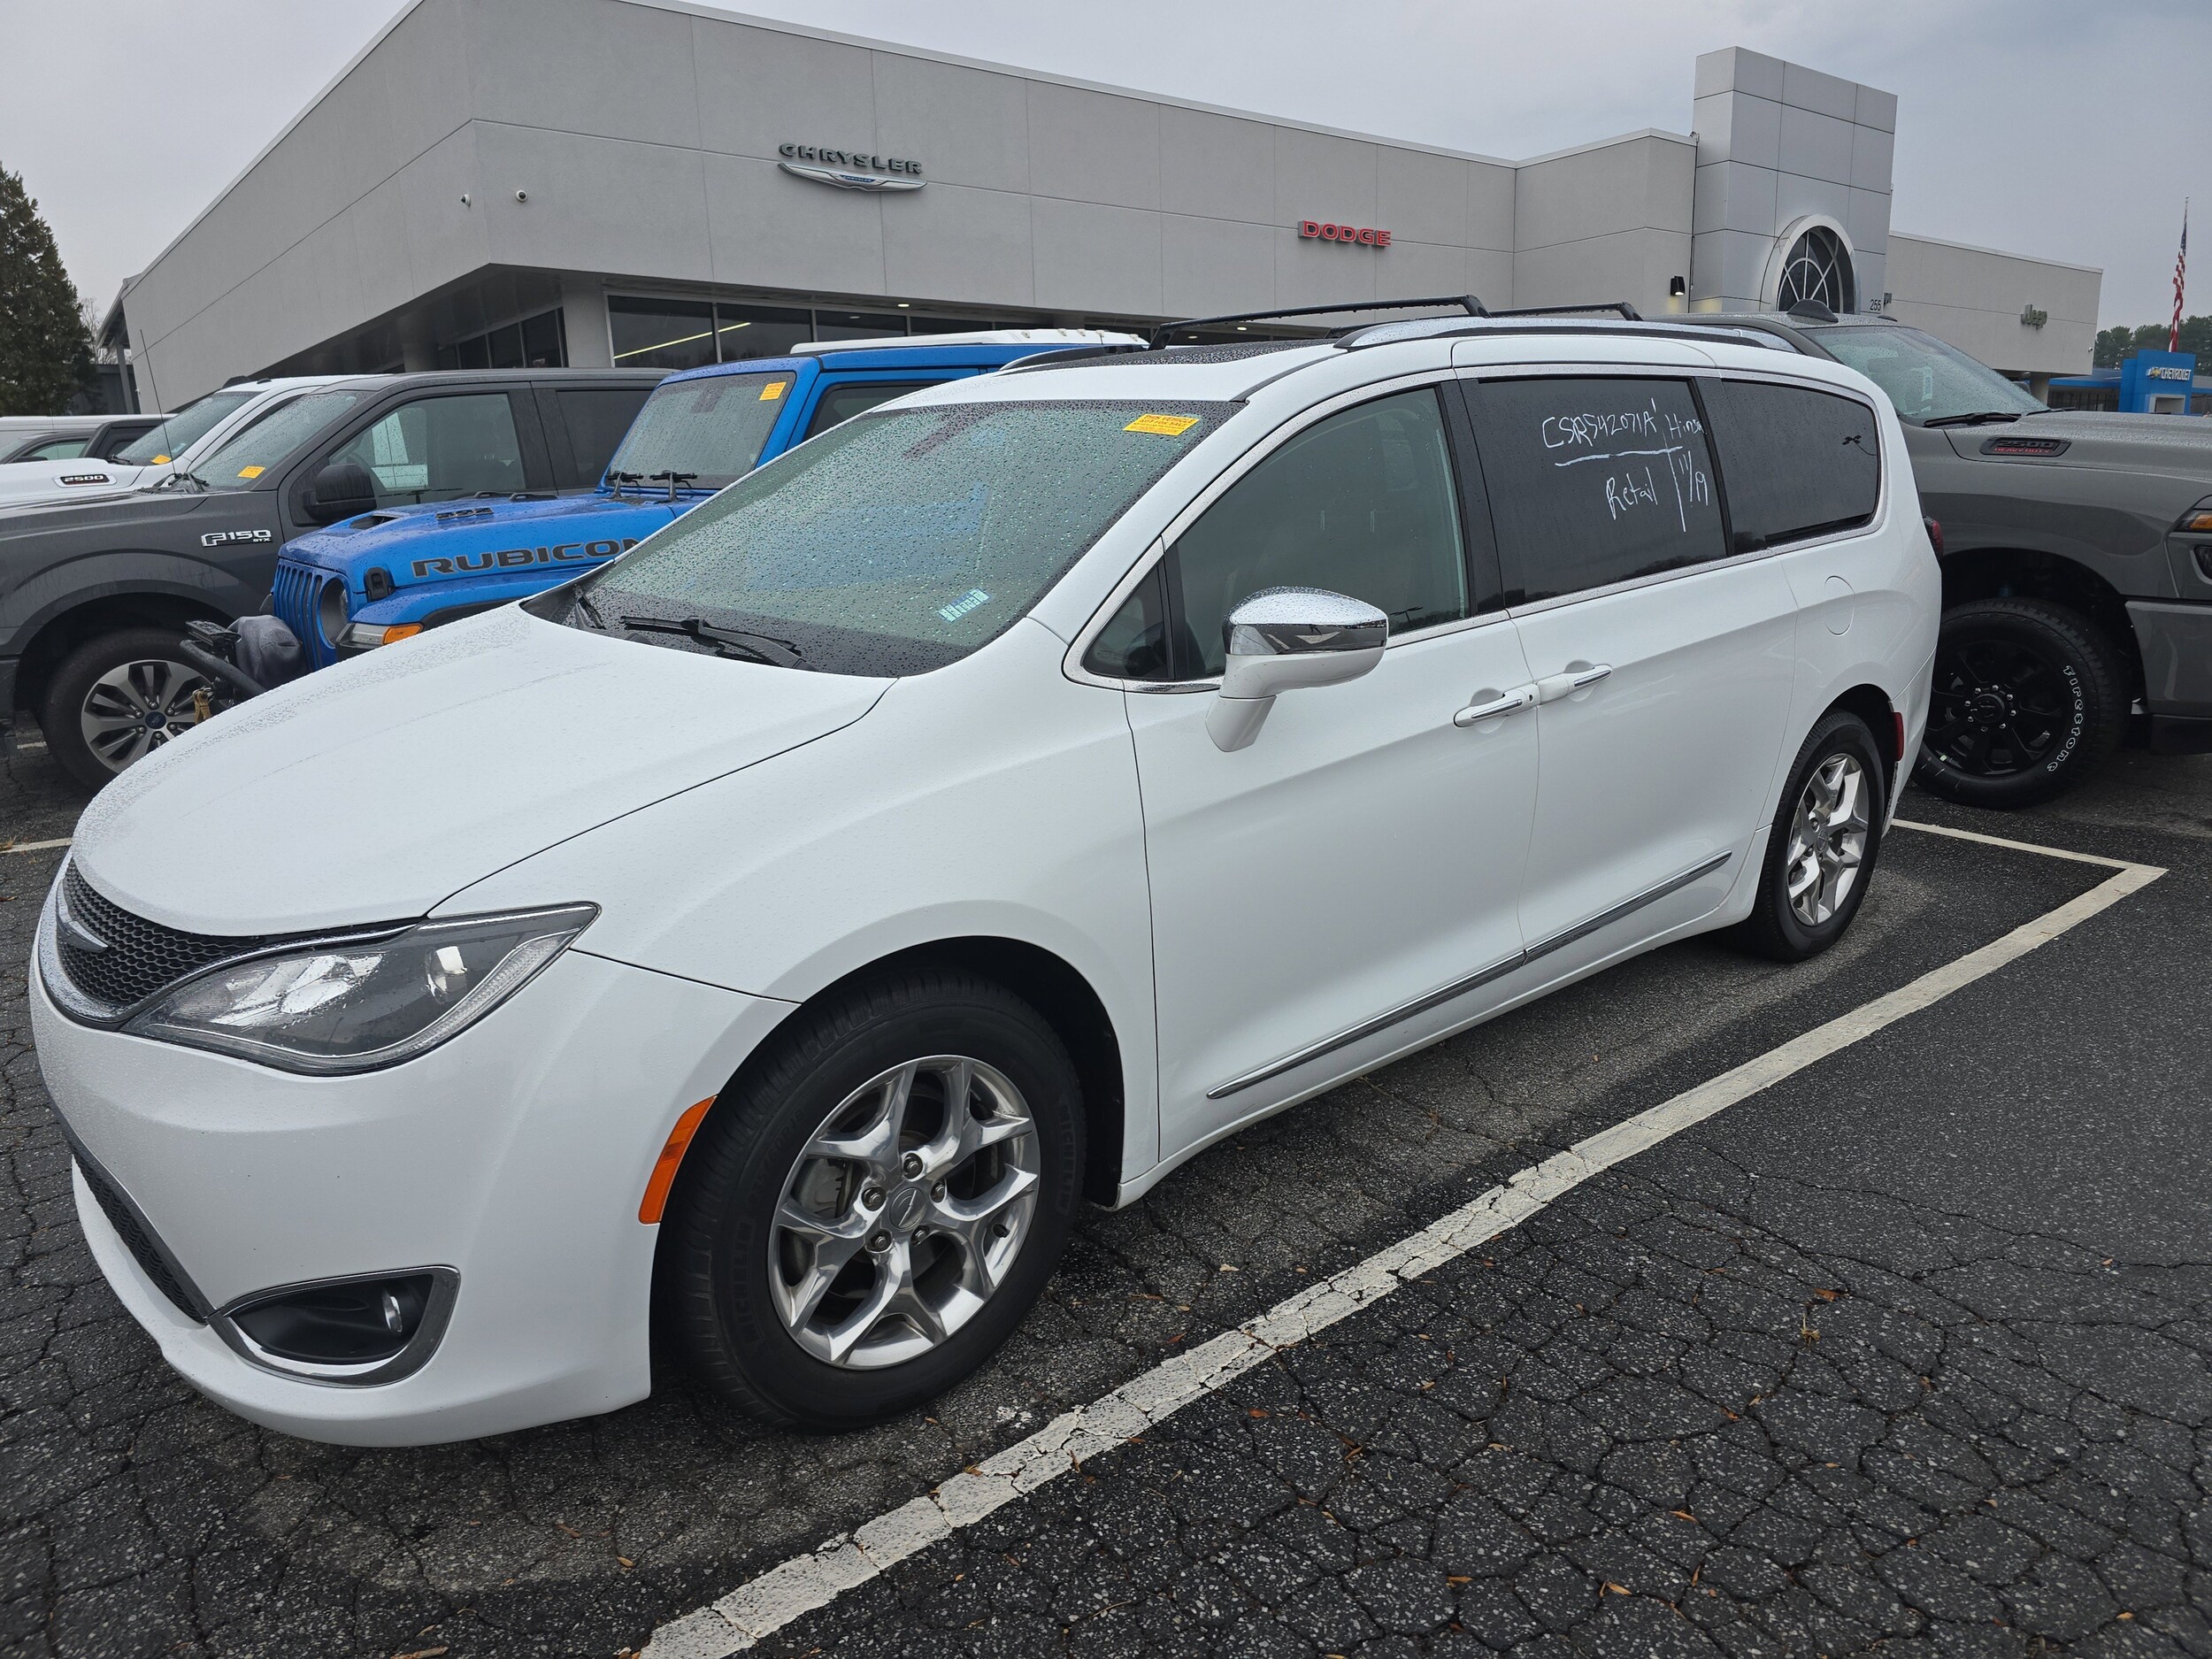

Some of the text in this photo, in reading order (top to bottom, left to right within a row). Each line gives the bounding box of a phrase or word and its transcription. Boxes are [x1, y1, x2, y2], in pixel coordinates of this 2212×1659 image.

[779, 142, 923, 173] CHRYSLER
[1298, 220, 1391, 247] DODGE
[1870, 298, 1881, 311] 255
[2021, 304, 2047, 330] Jeep
[2161, 367, 2192, 380] CHEVROLET
[1605, 466, 1658, 520] Retail
